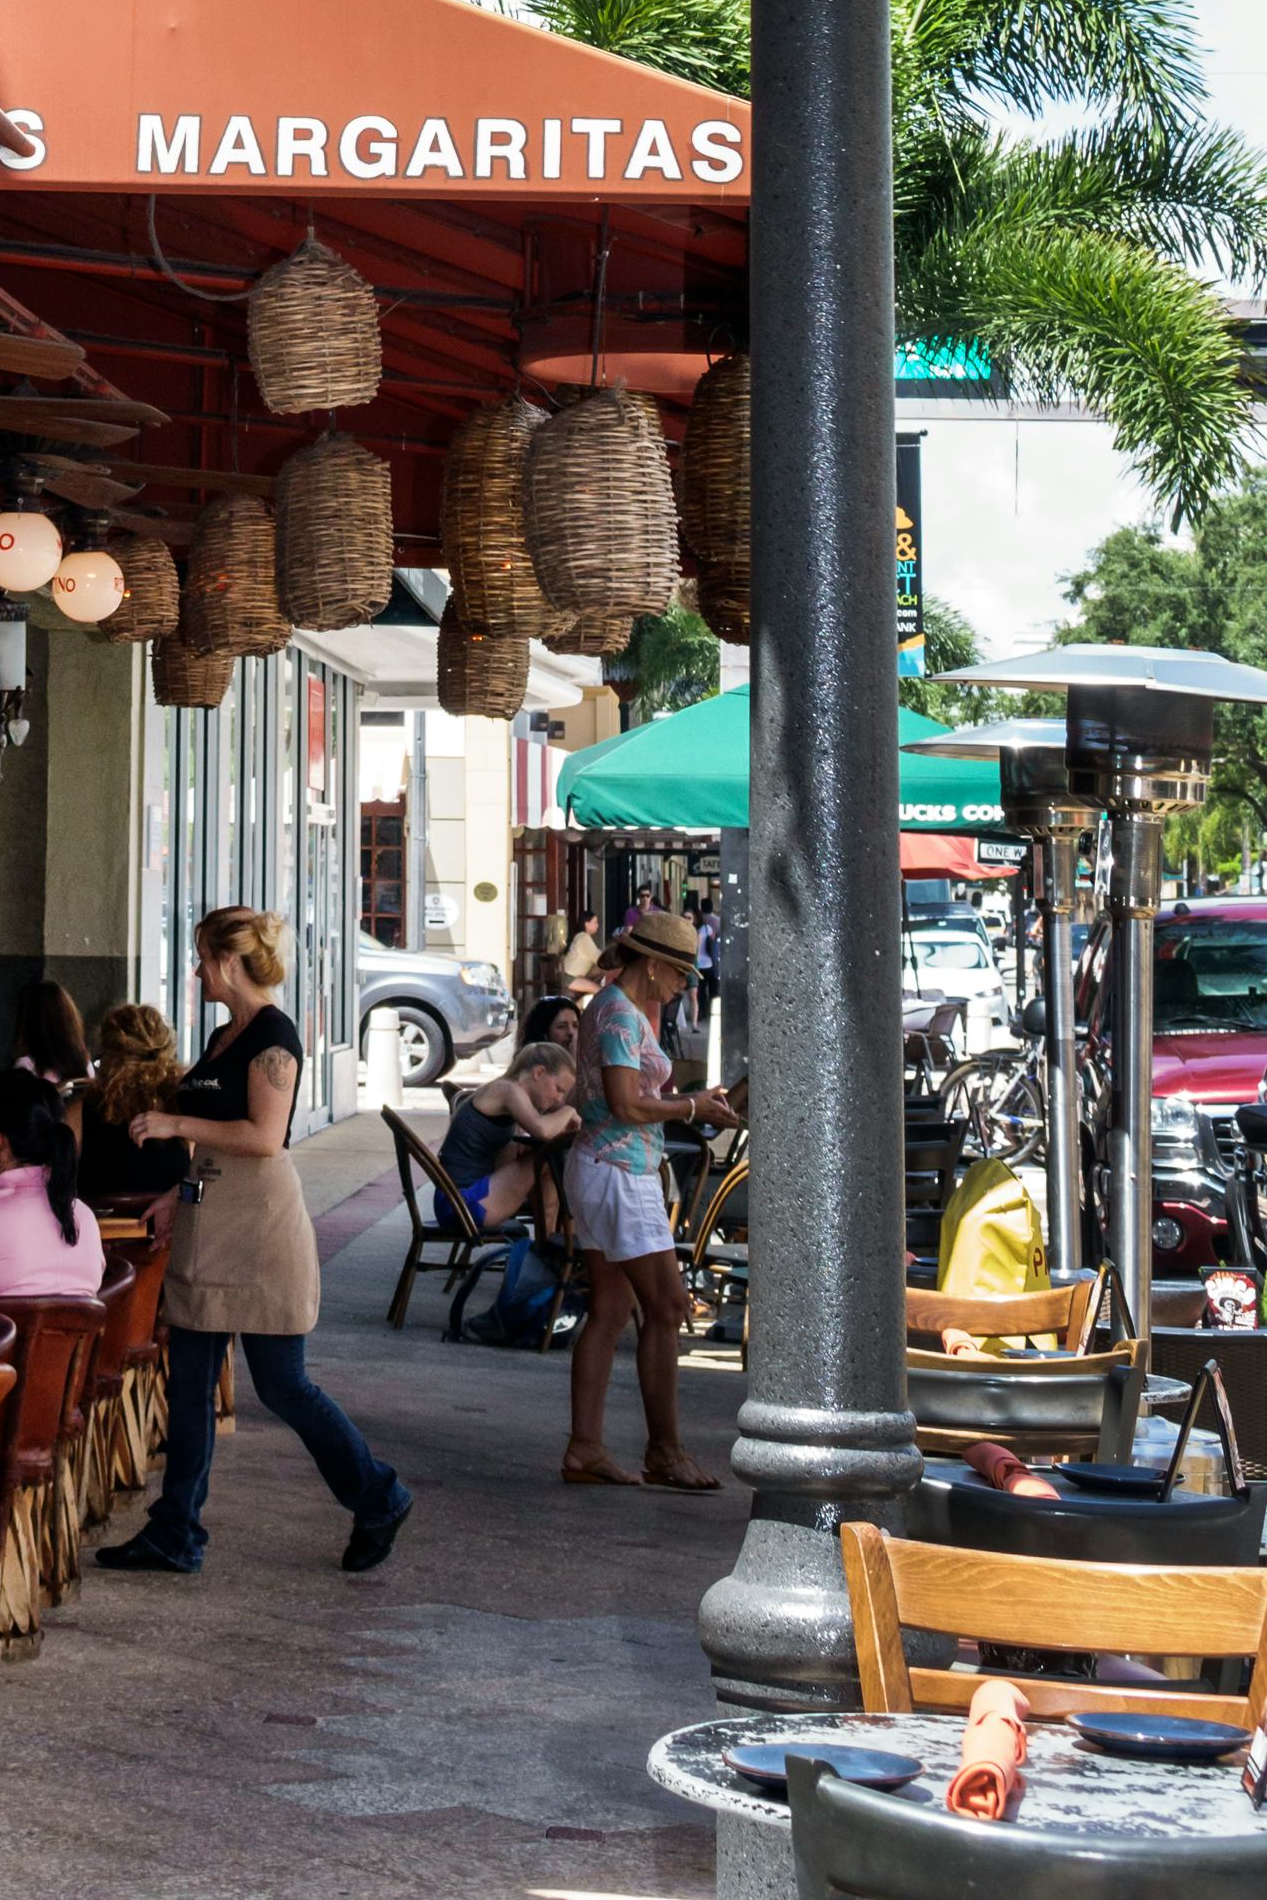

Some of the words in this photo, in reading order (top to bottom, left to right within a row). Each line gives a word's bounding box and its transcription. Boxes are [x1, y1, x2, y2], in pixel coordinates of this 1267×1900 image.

[137, 113, 745, 184] MARGARITAS
[896, 574, 916, 595] T
[987, 846, 1009, 858] ONE
